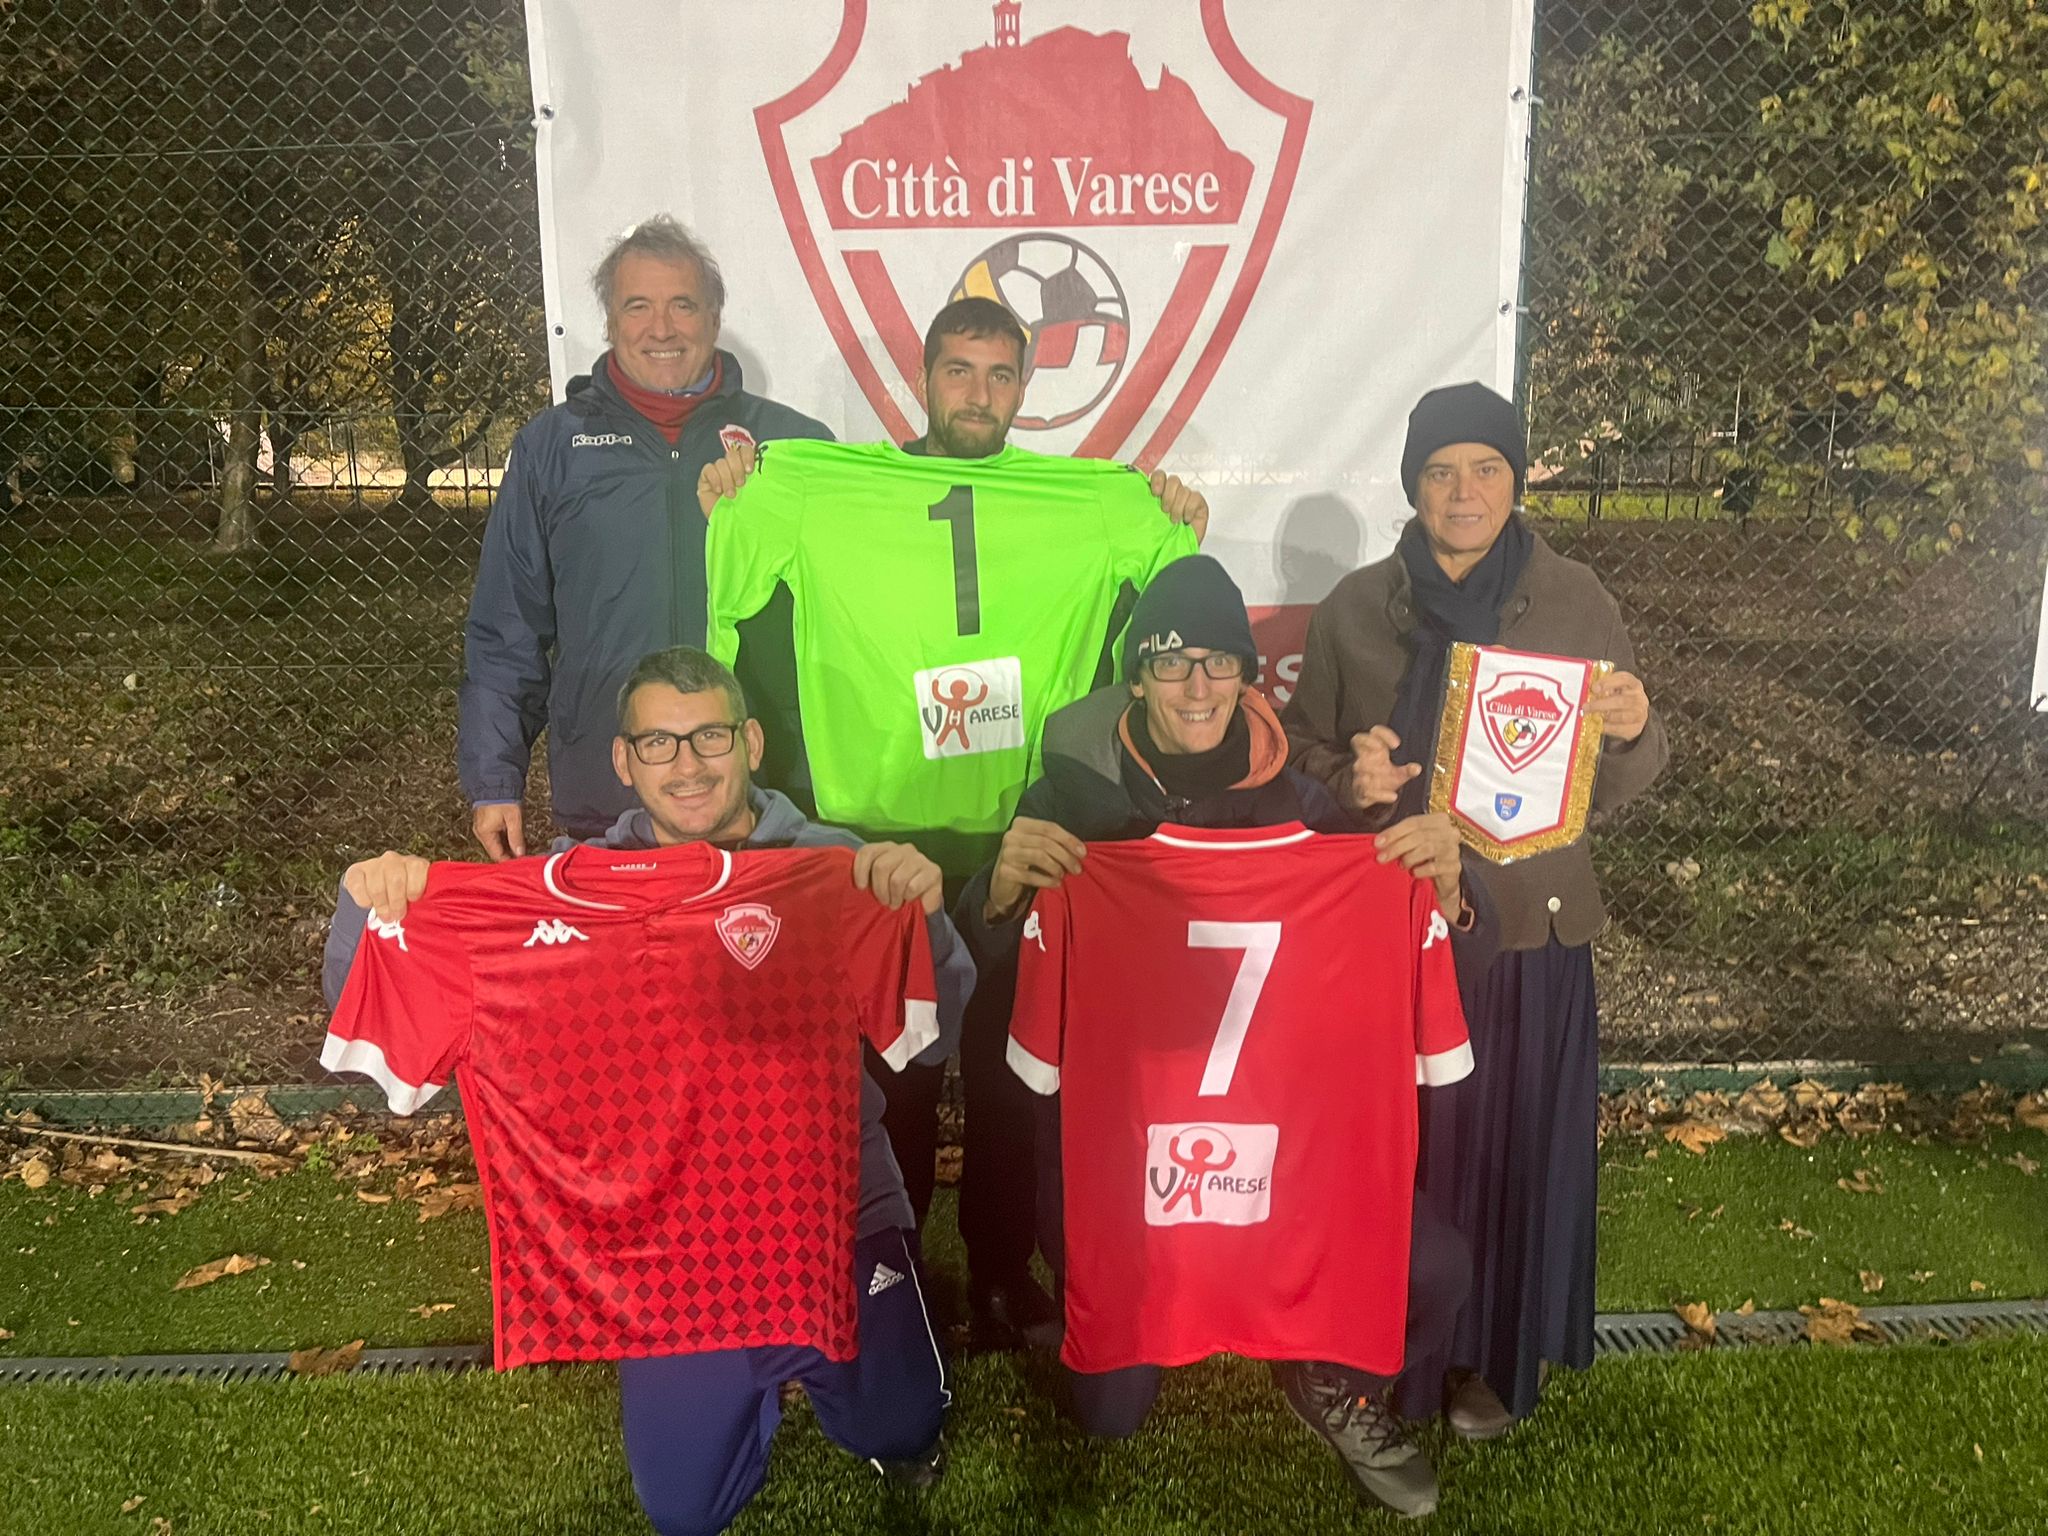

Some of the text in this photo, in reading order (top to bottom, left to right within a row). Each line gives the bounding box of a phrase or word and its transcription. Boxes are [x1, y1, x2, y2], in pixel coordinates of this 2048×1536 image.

[841, 155, 1220, 219] Città di Varese
[572, 433, 633, 447] Kappa
[928, 484, 981, 637] 1
[1138, 629, 1184, 656] FILA
[1489, 701, 1557, 720] Città di Varese
[1187, 920, 1282, 1097] 7
